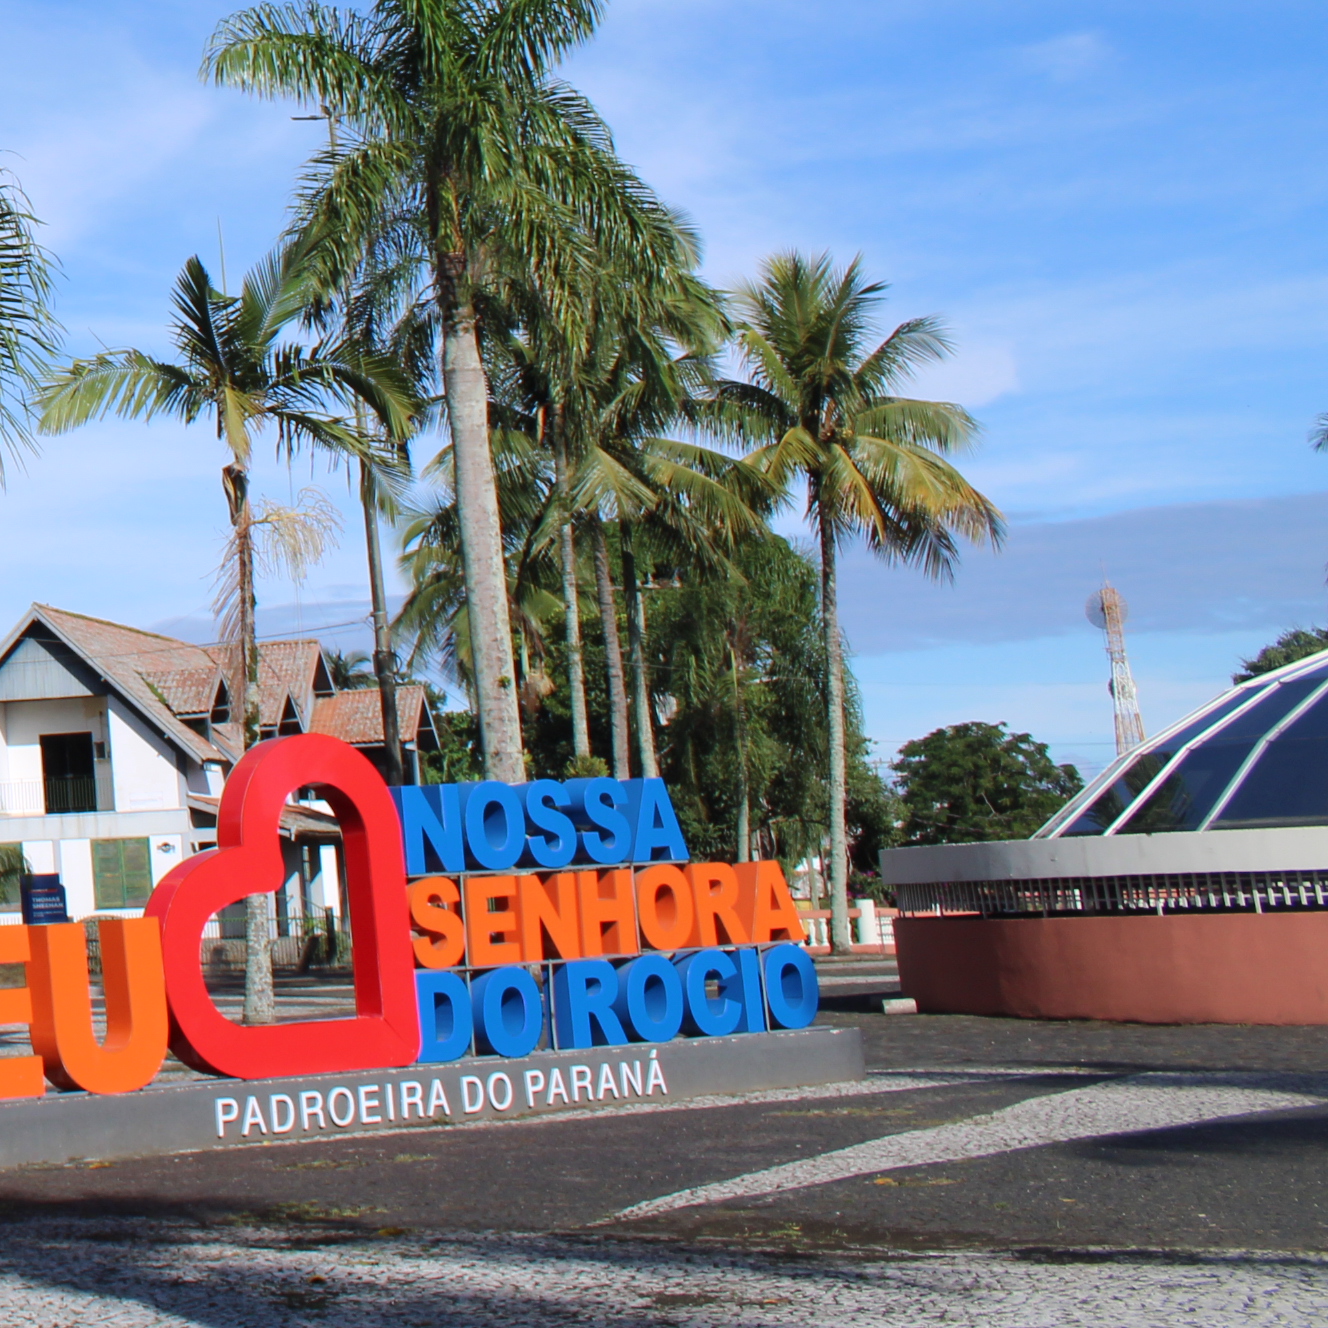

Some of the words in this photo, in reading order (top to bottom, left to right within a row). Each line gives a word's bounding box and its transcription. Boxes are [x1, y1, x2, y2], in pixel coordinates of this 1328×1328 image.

[389, 776, 689, 872] NOSSA
[407, 859, 808, 969] SENHORA
[416, 966, 543, 1063] DO
[554, 943, 819, 1049] ROCIO
[215, 1078, 450, 1138] PADROEIRA
[459, 1071, 514, 1115] DO
[523, 1048, 669, 1108] PARANÁ
